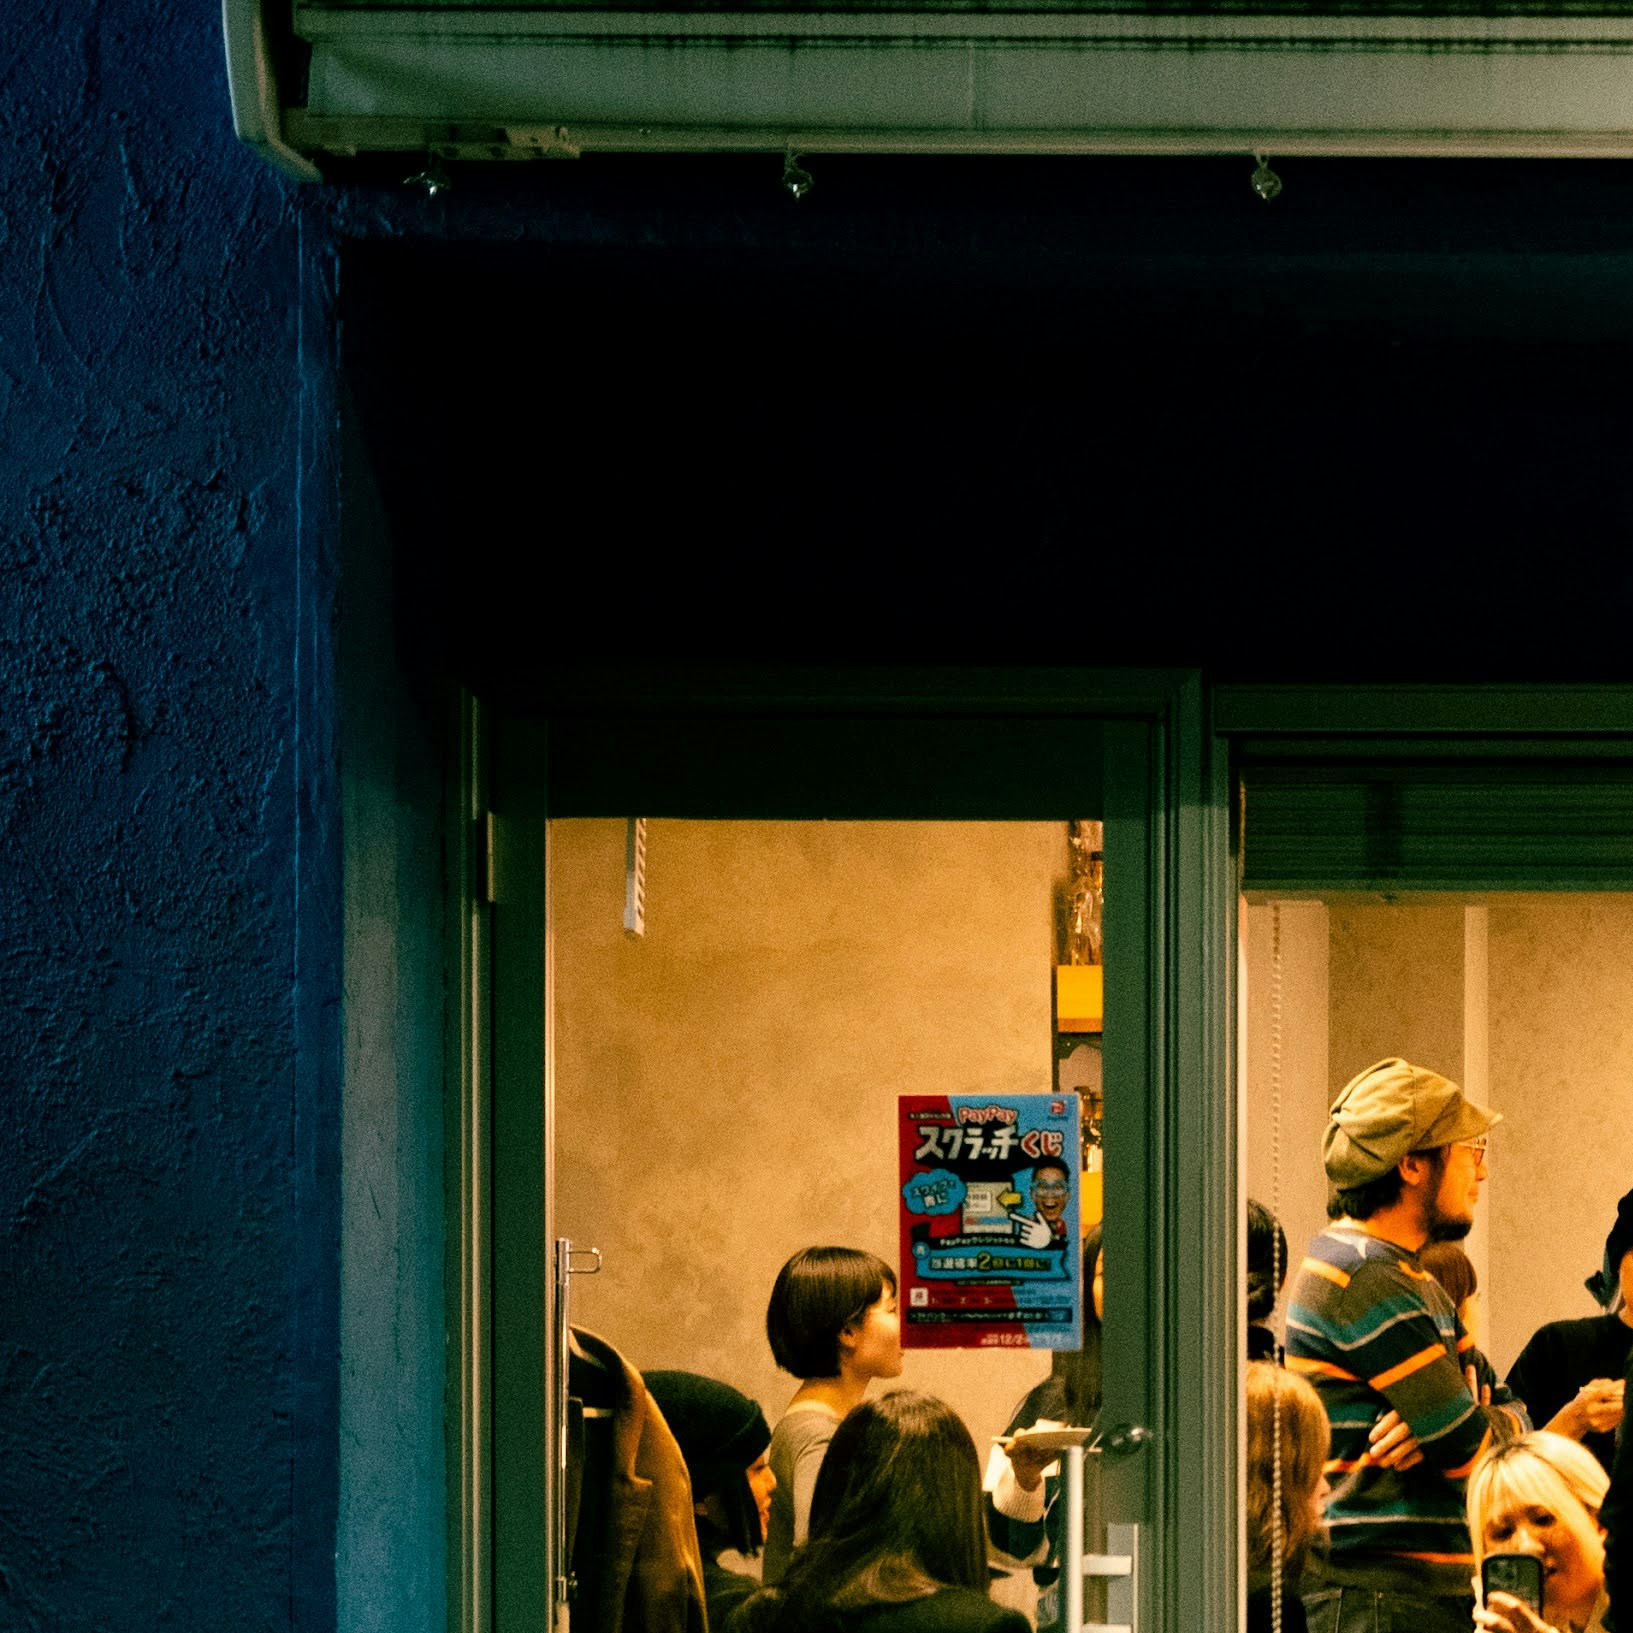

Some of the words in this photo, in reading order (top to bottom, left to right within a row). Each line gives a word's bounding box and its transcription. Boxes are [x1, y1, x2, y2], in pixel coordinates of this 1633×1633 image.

[958, 1105, 1018, 1124] PayPay
[915, 1125, 1063, 1160] スクラッチくじ
